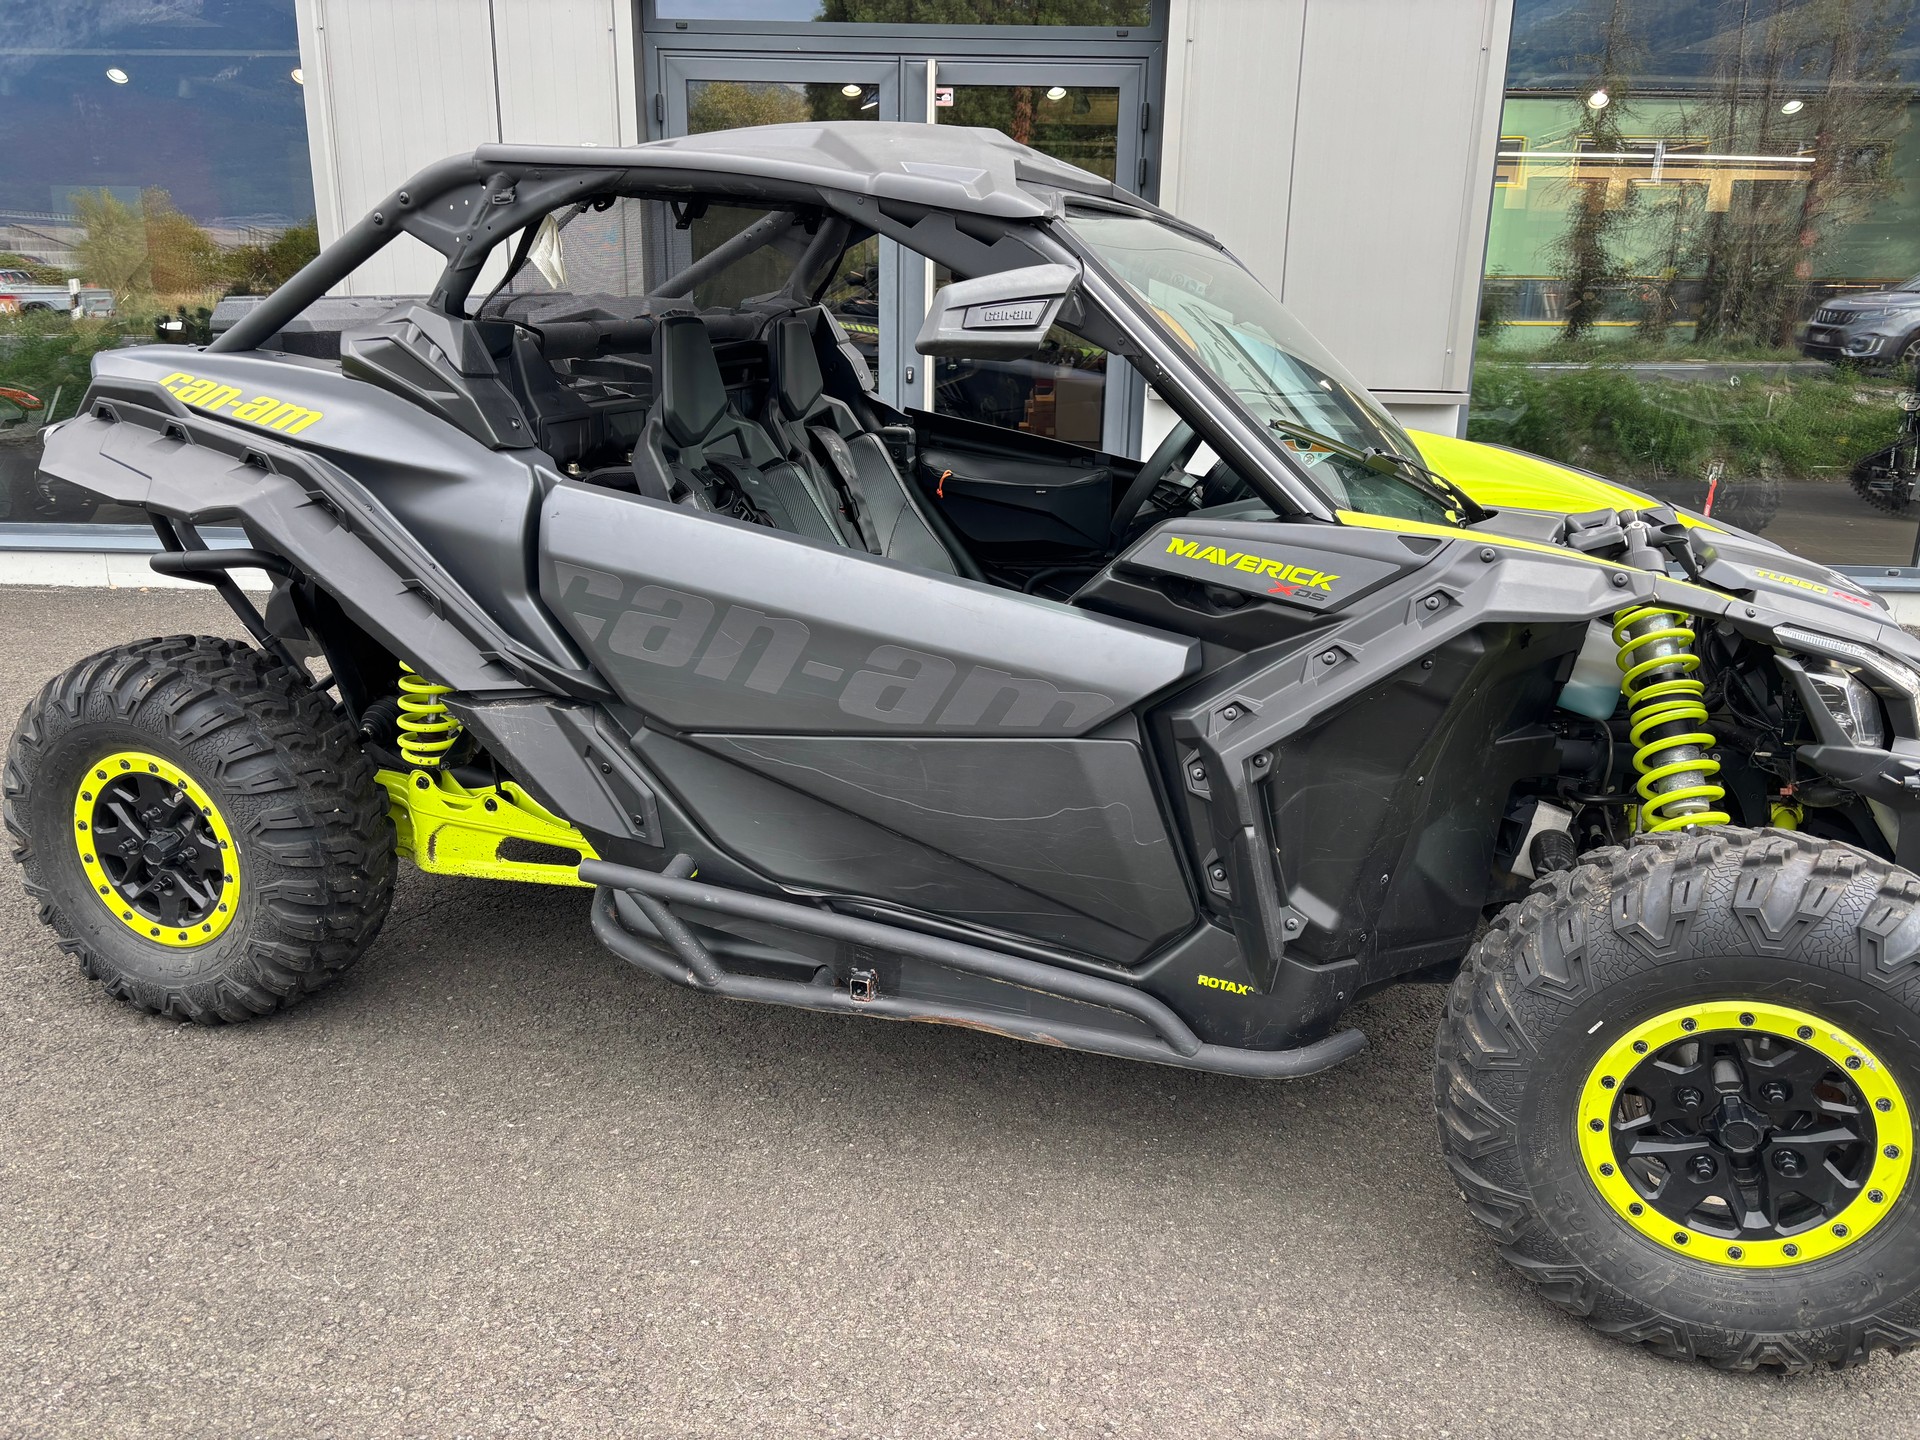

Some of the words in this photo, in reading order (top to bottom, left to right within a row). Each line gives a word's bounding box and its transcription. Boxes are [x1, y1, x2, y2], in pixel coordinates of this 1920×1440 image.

[983, 310, 1033, 322] can-am
[159, 372, 324, 435] can-am
[1165, 536, 1341, 592] MAVERICK
[1755, 568, 1829, 595] TURBO
[554, 560, 1115, 729] can-am
[1197, 974, 1248, 996] ROTAX
